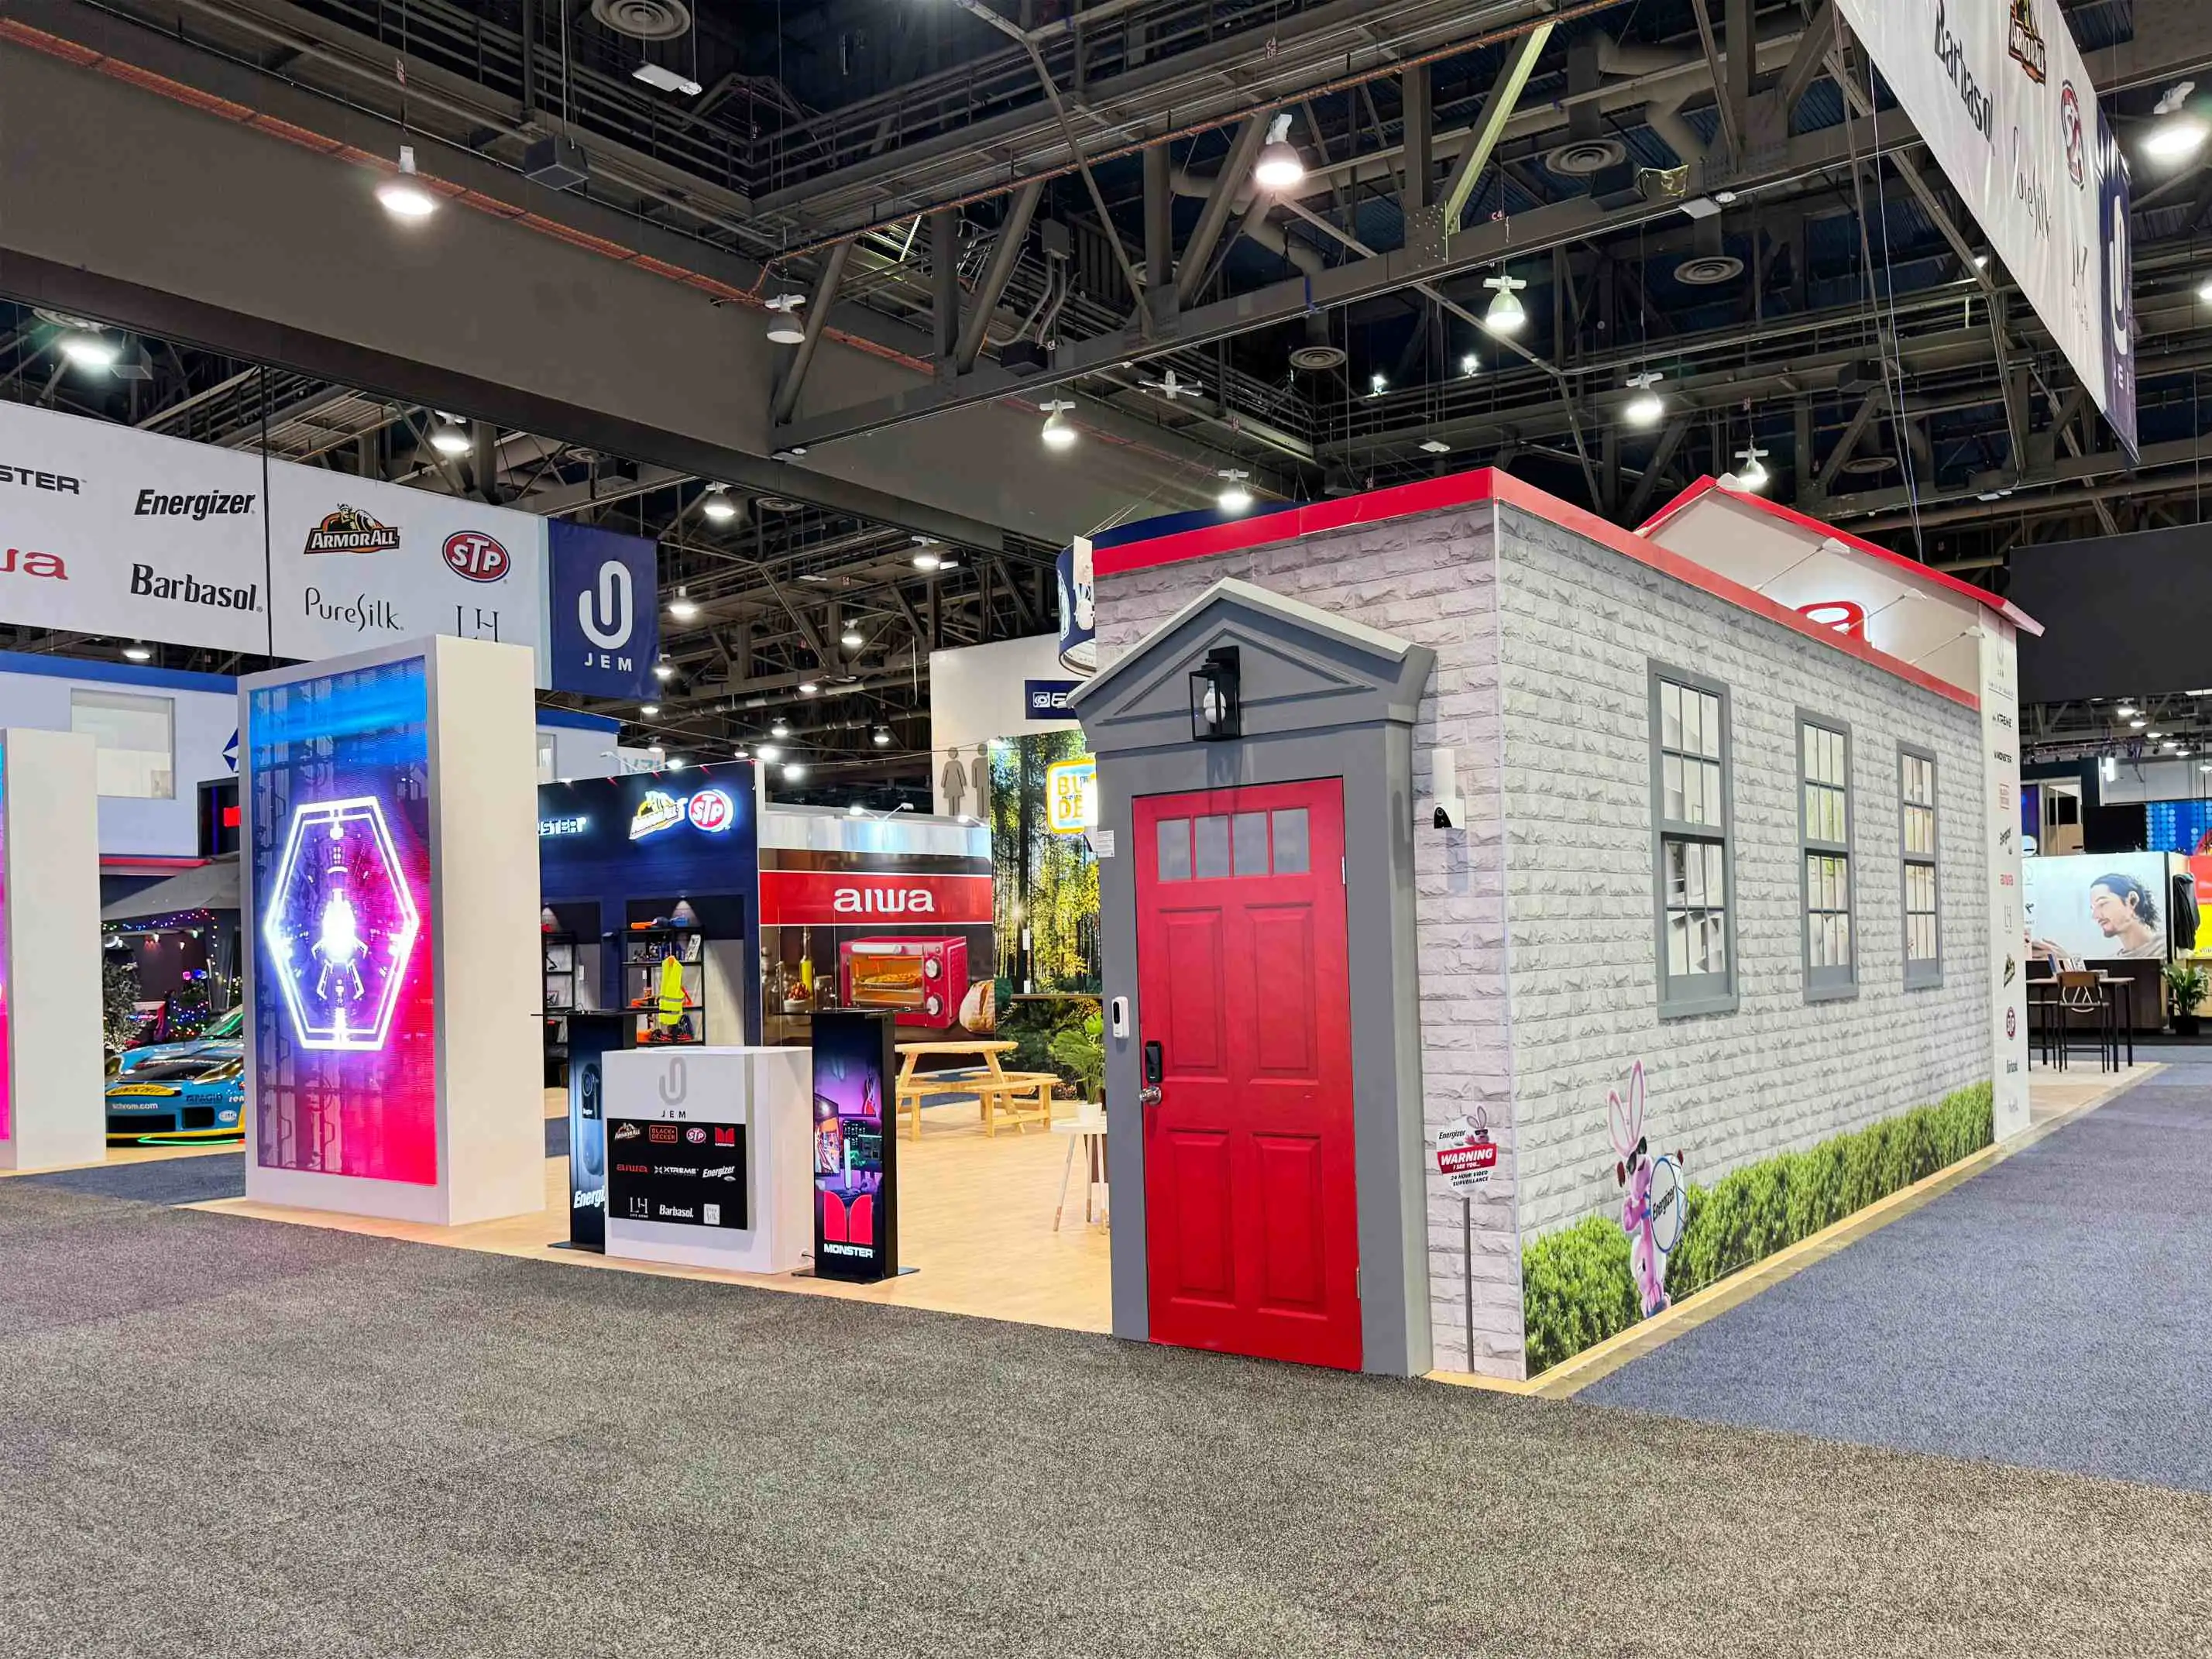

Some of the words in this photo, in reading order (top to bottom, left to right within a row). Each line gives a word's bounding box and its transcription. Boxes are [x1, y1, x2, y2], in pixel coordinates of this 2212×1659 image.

[134, 489, 256, 520] Energizer
[452, 537, 502, 573] STP
[130, 563, 256, 611] Barbasol
[584, 652, 632, 672] JEM
[692, 795, 725, 825] STP
[538, 818, 586, 836] STER
[833, 888, 935, 912] aiwa
[661, 1109, 686, 1118] JEM
[687, 1128, 704, 1142] STP
[1438, 1129, 1466, 1139] Energizer
[1441, 1148, 1494, 1166] WARNING
[617, 1163, 648, 1173] aiwa
[663, 1166, 697, 1174] XTREME
[702, 1166, 735, 1178] Energizer
[1453, 1176, 1489, 1187] SURVEILLANCE
[659, 1204, 692, 1218] Barbasol
[1653, 1185, 1675, 1222] Energizer
[823, 1243, 874, 1259] MONSTER
